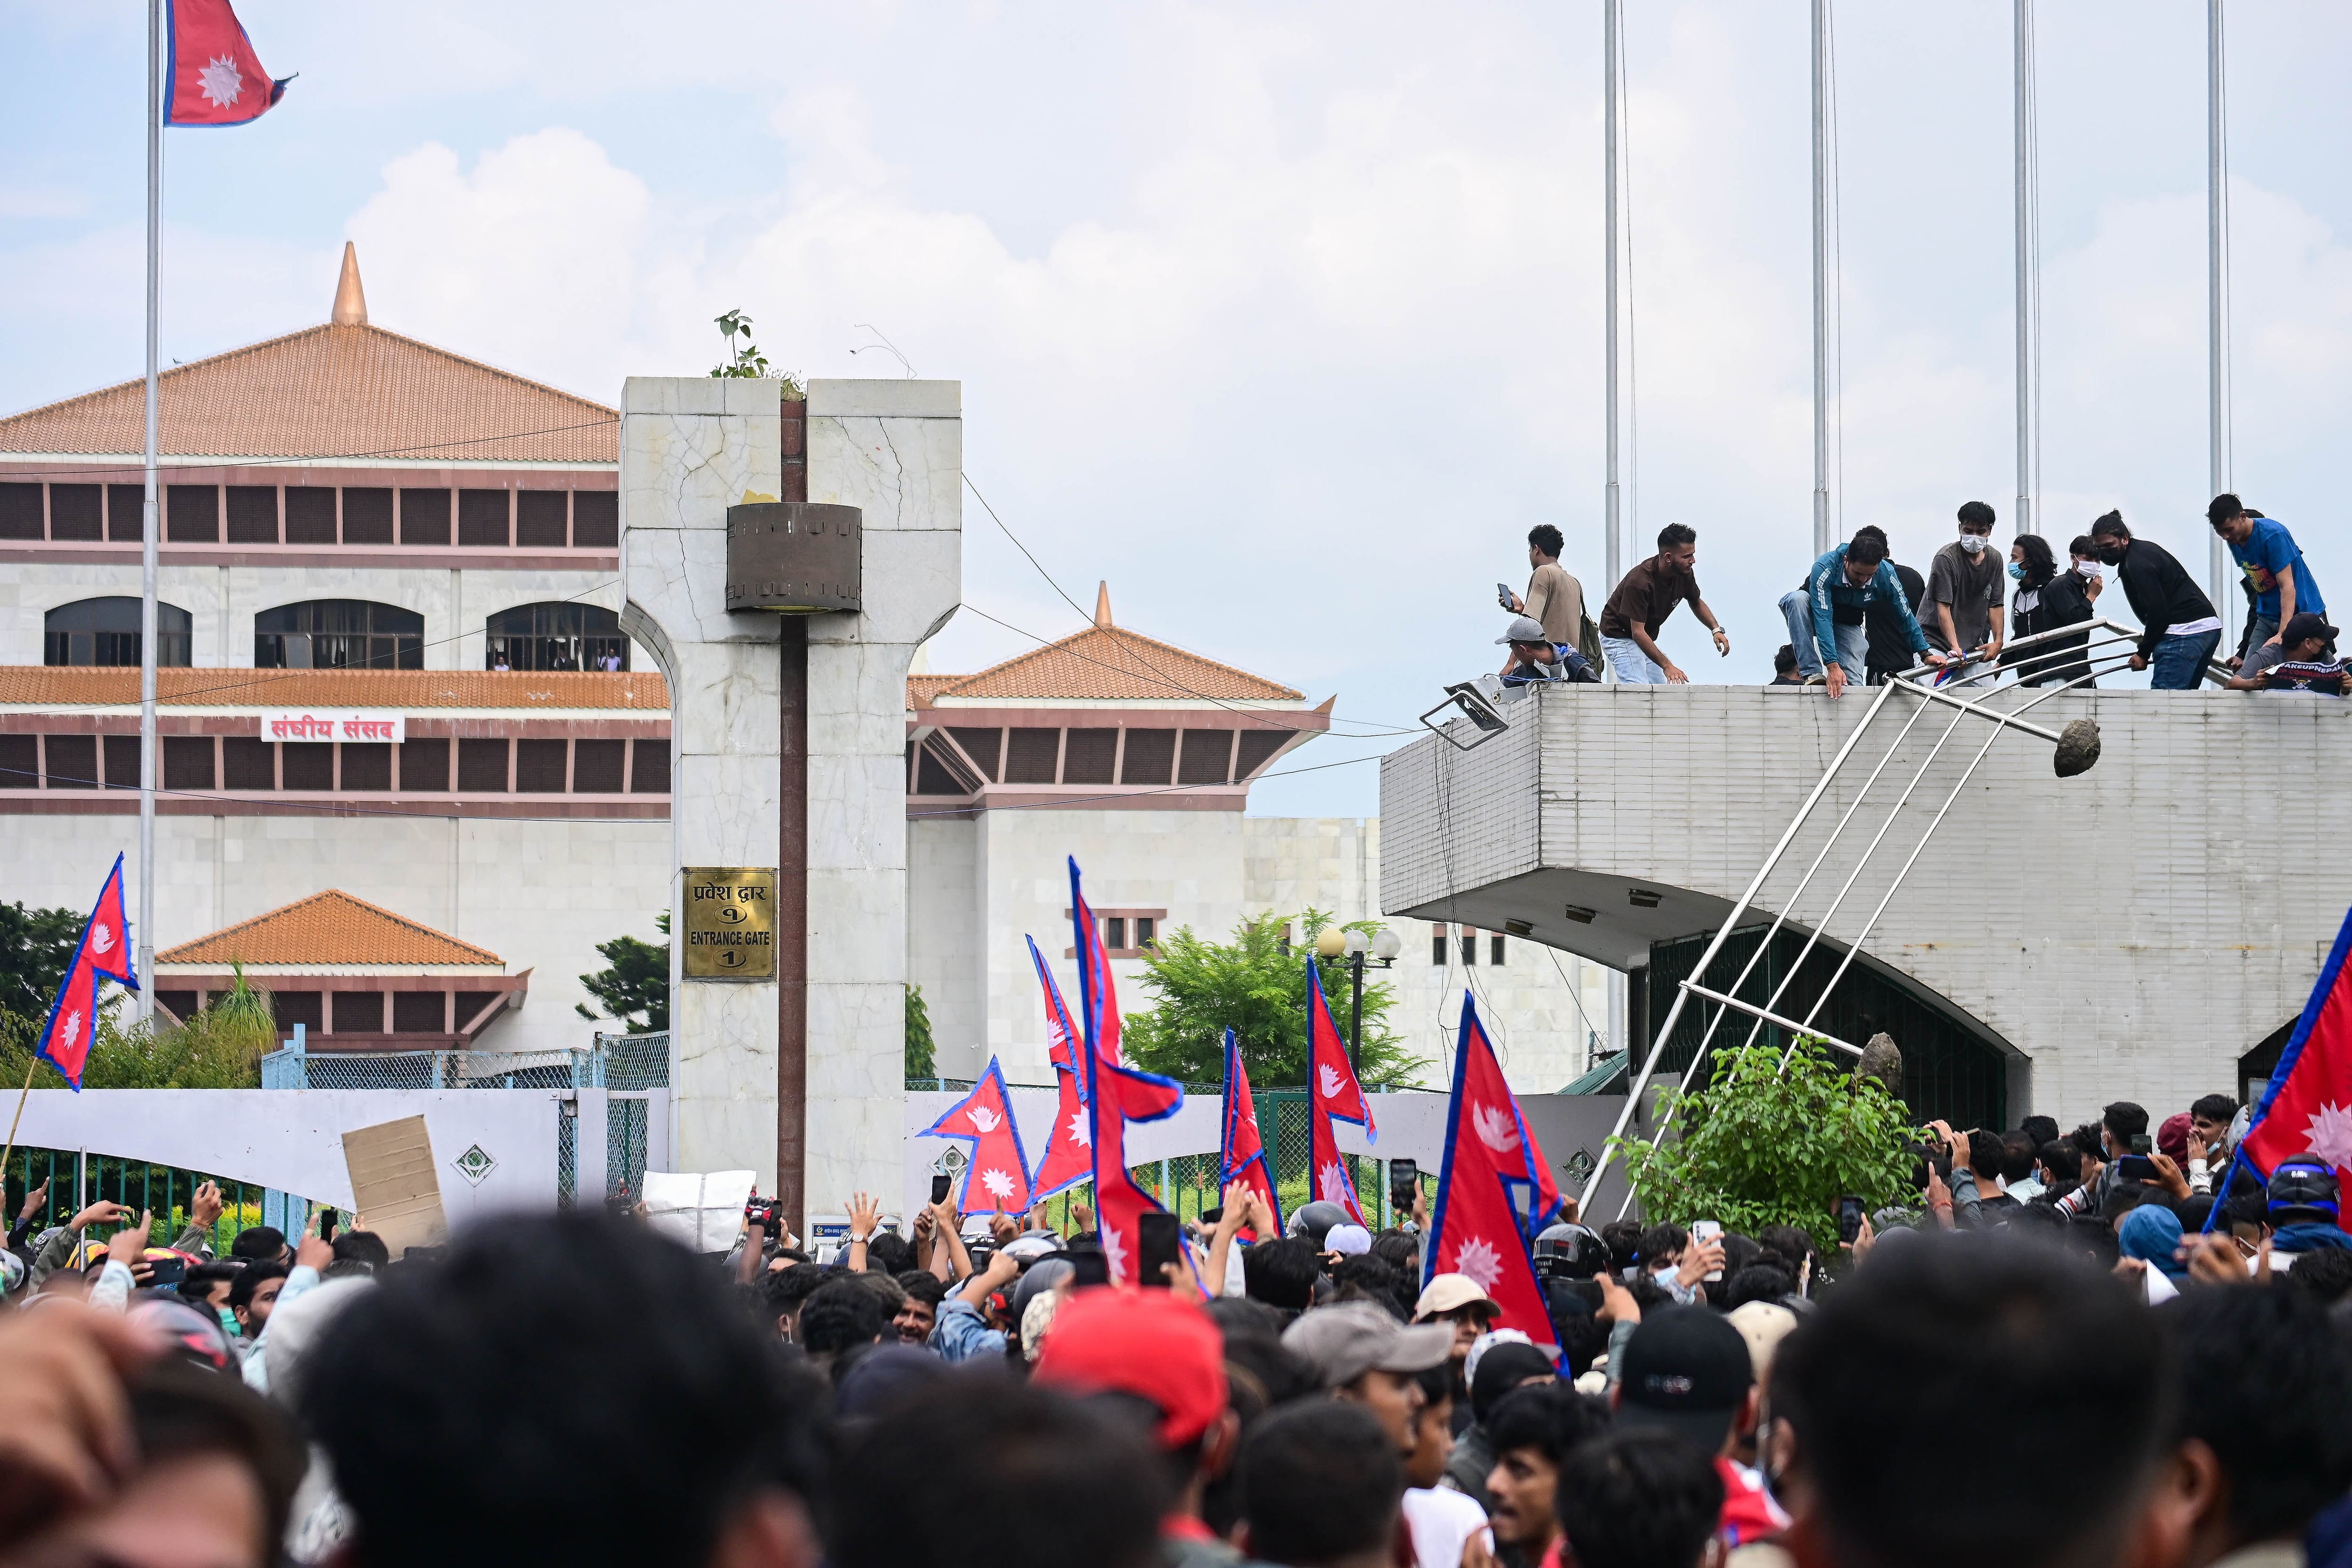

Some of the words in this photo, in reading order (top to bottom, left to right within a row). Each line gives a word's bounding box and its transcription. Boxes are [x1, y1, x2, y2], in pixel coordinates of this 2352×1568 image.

[271, 714, 334, 738] संघीय
[343, 715, 395, 739] संसद
[693, 881, 732, 901] प्रवेश
[738, 886, 768, 903] द्वार
[722, 908, 738, 920] १
[691, 931, 742, 945] ENTRANCE
[745, 931, 770, 945] GATE
[722, 950, 734, 965] 1
